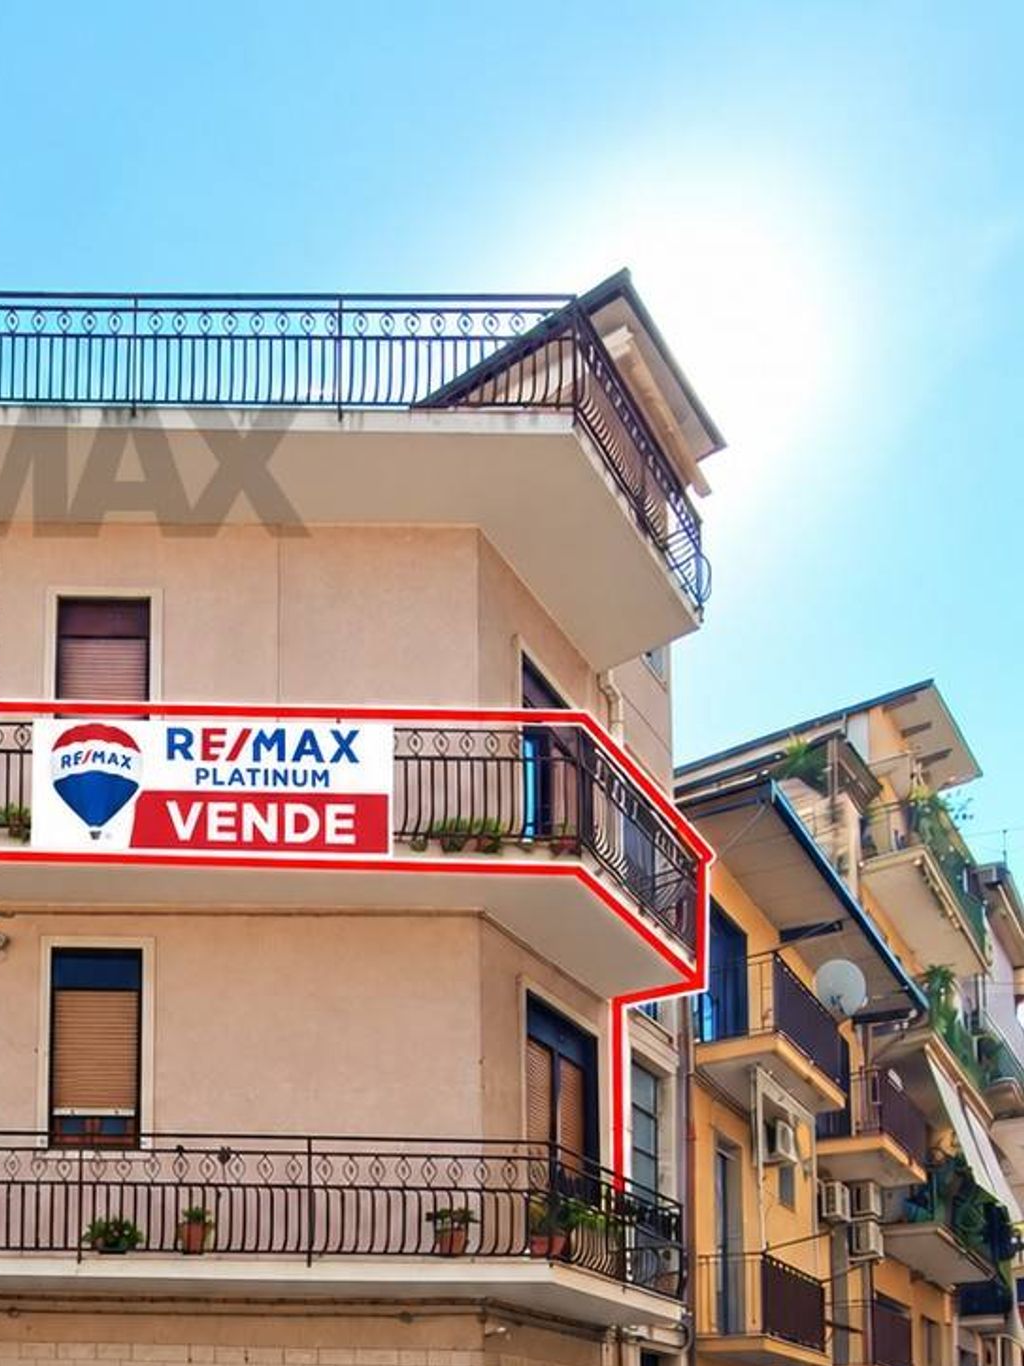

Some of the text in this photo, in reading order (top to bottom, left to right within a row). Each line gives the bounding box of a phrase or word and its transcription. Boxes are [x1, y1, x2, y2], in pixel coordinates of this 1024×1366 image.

[166, 727, 360, 763] RE/MAX
[60, 749, 132, 770] RE/MAX
[195, 767, 330, 788] PLATINUM
[165, 801, 357, 845] VENDE
